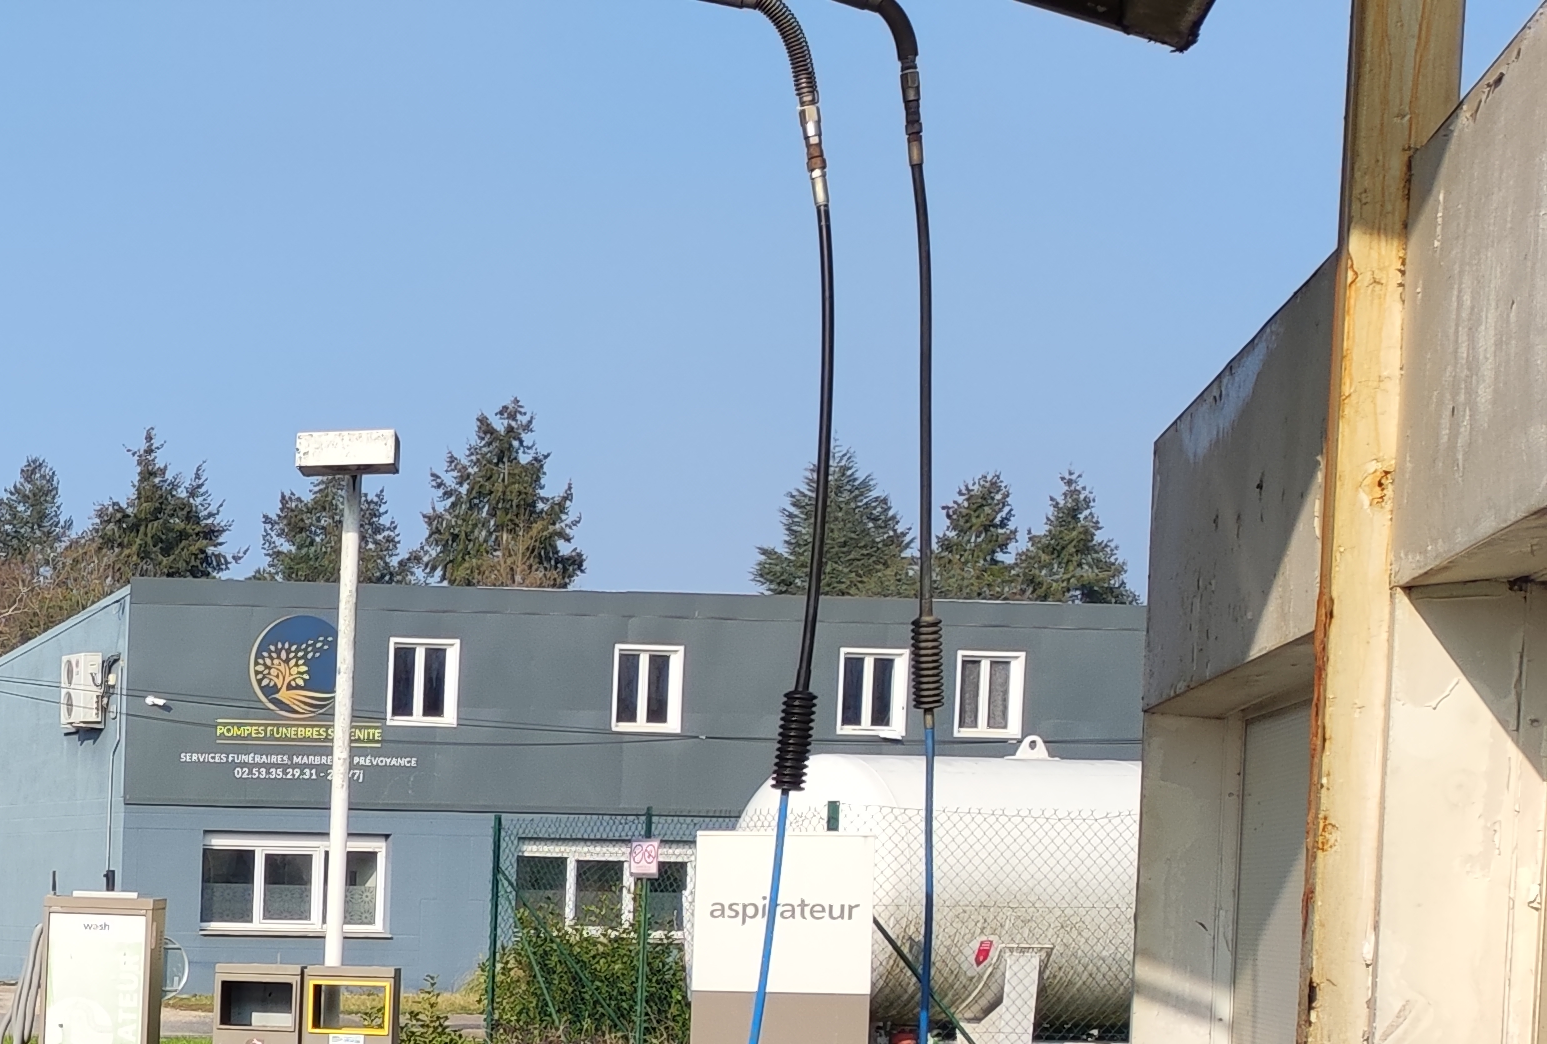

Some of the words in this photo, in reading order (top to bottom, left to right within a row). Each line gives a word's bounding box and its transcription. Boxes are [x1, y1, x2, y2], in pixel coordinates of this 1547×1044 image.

[216, 725, 265, 738] POMPES
[266, 726, 327, 739] FUNEBRES
[327, 727, 382, 741] SENITE
[180, 752, 226, 763] SERVICES
[228, 752, 292, 765] FUNÉRAIRES,
[293, 755, 333, 765] MARBRE
[353, 755, 418, 767] PRÉVOYANCE
[233, 767, 317, 780] 02.53.35.29.31
[326, 769, 364, 783] 2/7j
[709, 895, 861, 927] aspiateur
[83, 922, 110, 931] wash
